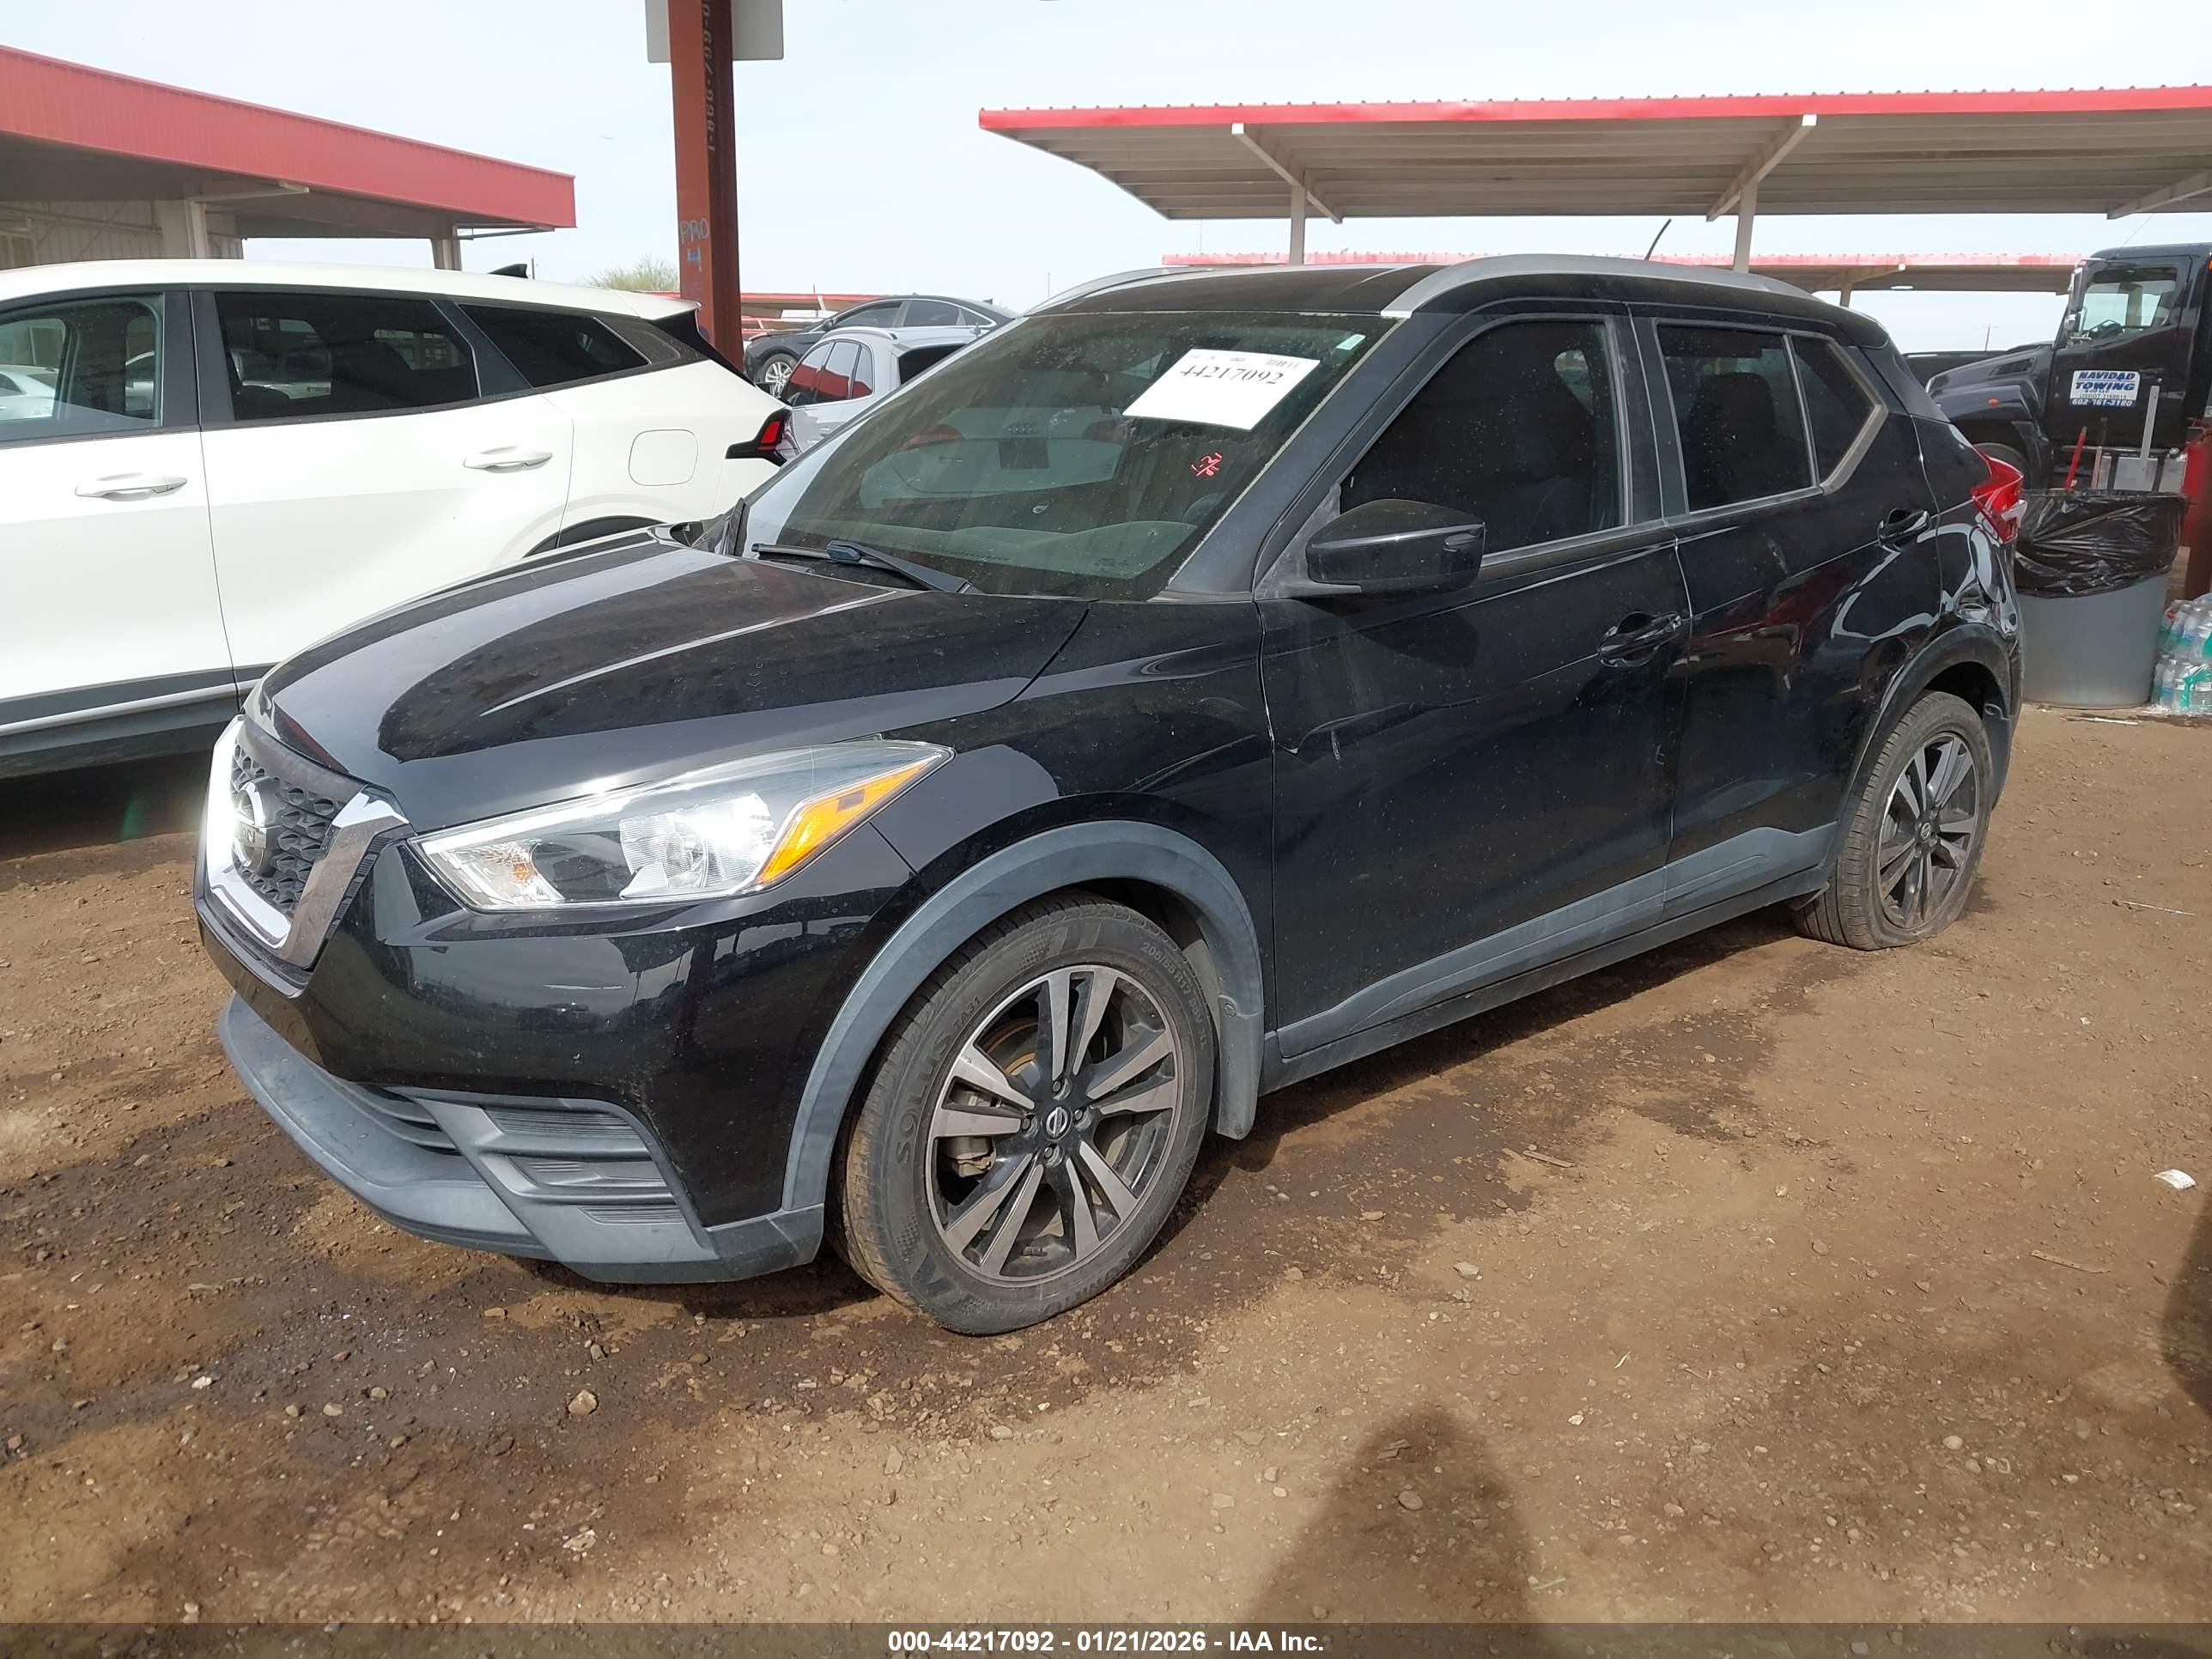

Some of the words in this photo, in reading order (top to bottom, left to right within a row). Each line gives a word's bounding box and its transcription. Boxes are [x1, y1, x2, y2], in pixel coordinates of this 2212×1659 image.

[1180, 365, 1285, 385] 44217092
[2075, 382, 2136, 391] TOWING
[952, 995, 981, 1029] TA31
